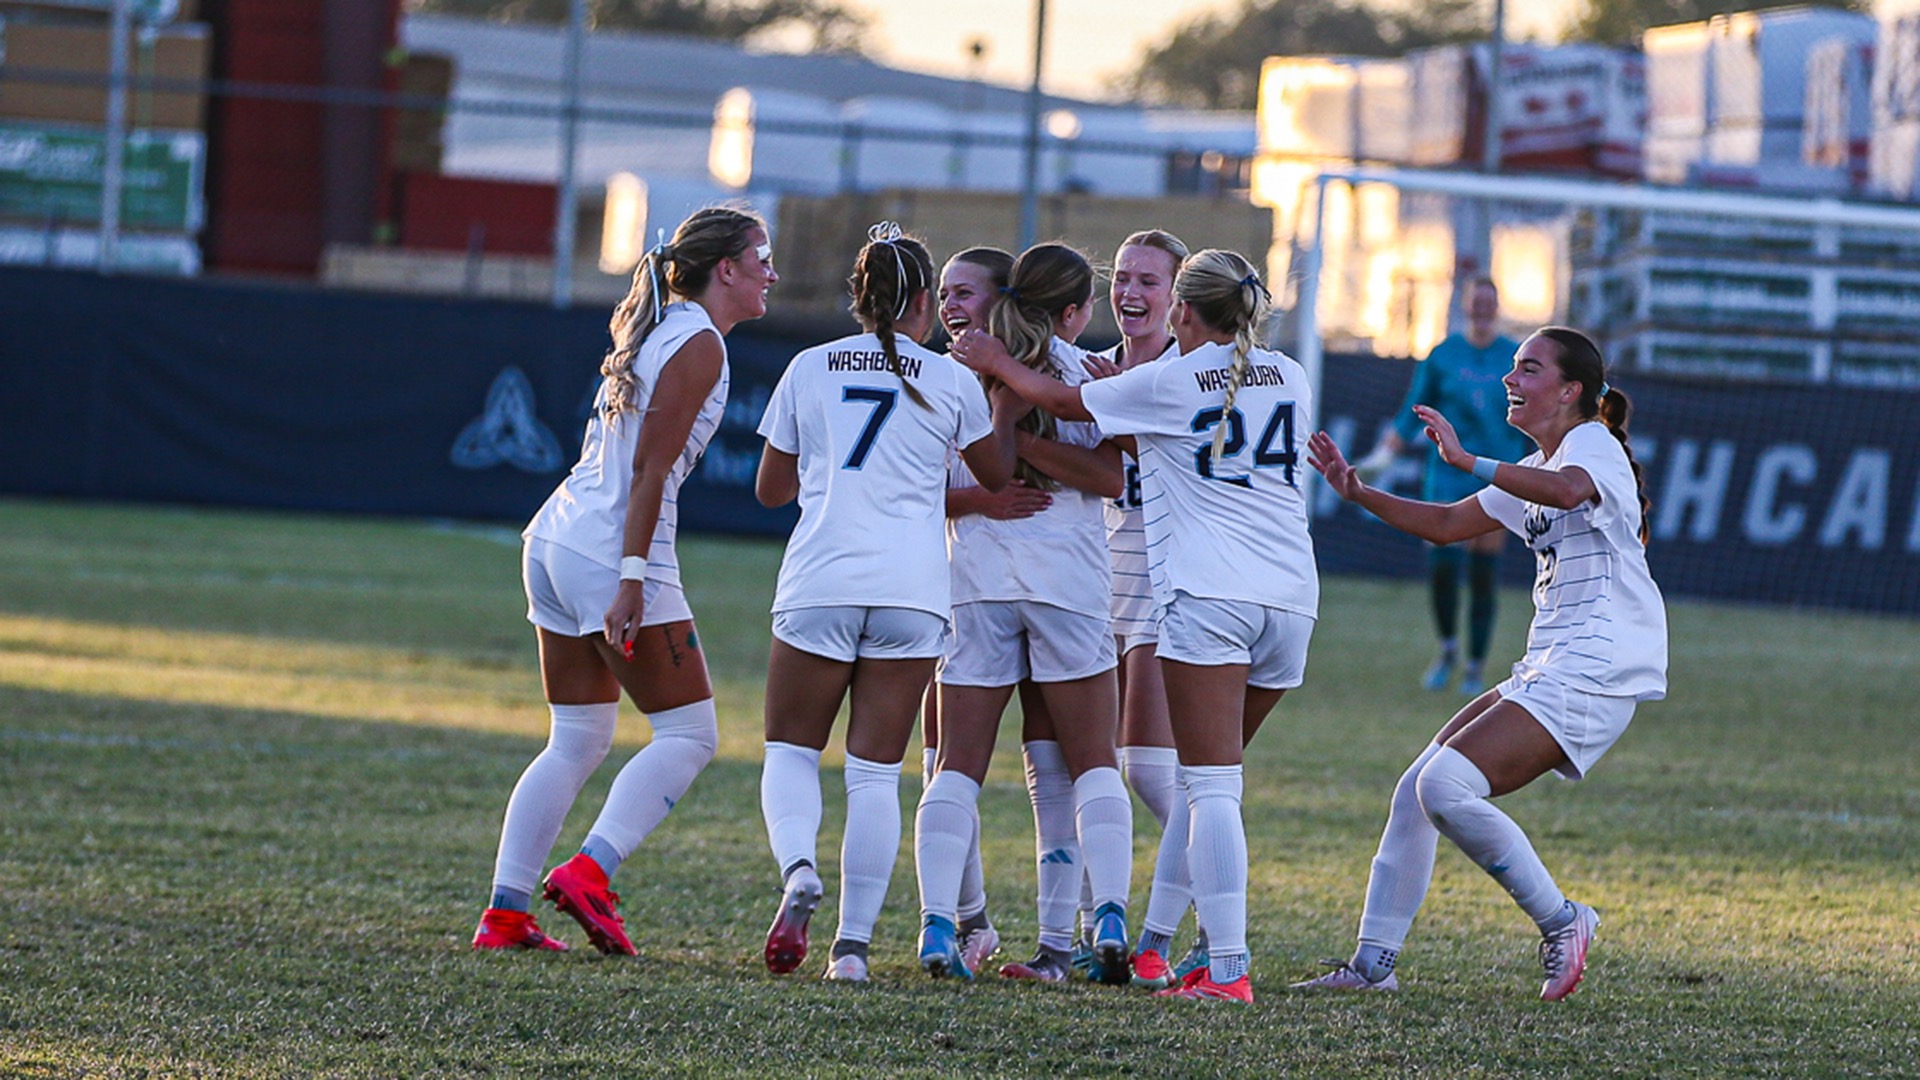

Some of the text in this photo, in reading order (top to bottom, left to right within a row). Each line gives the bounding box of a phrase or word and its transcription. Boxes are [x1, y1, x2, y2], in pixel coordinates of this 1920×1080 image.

[1194, 364, 1285, 393] WASBURN
[841, 385, 899, 471] 7
[1190, 400, 1298, 489] 24
